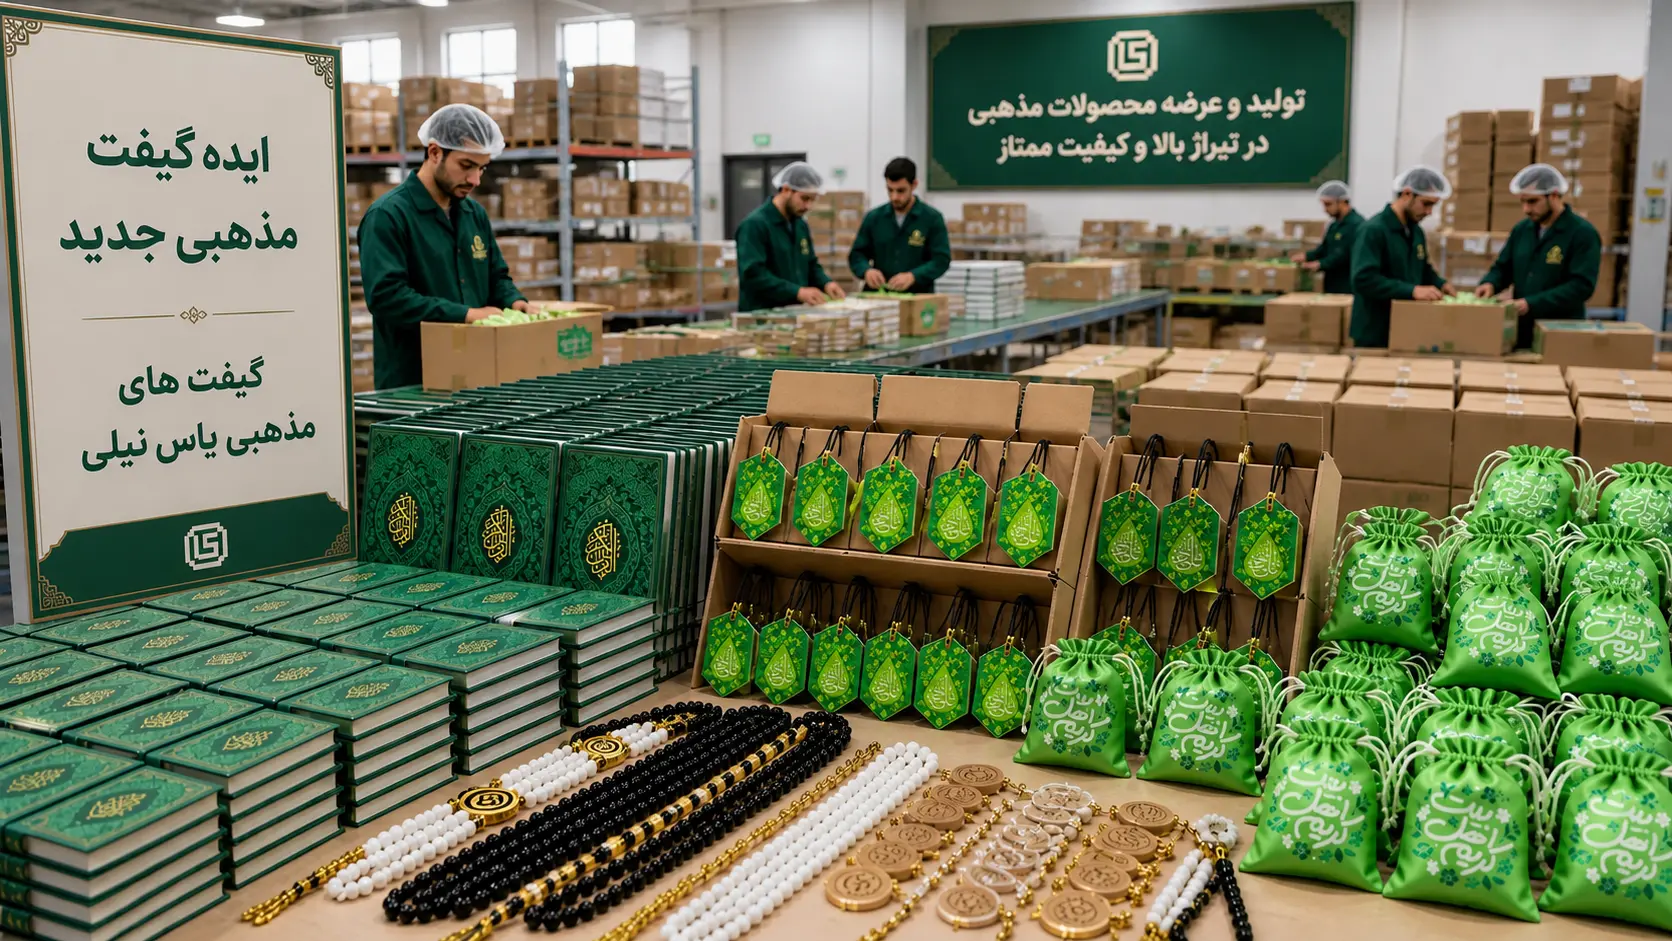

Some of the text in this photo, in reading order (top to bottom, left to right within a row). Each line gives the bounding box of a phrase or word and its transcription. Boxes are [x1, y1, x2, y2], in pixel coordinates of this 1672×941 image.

[968, 88, 1307, 126] تولید و عرضه محصولات مذهبی
[87, 126, 270, 185] ایده گیفت
[996, 131, 1270, 165] در تیراژ بالا و کیفیت ممتاز
[60, 211, 298, 265] مذهبی جدید
[118, 356, 265, 406] گیفت های
[81, 411, 316, 473] مذهبی یاس نیلی
